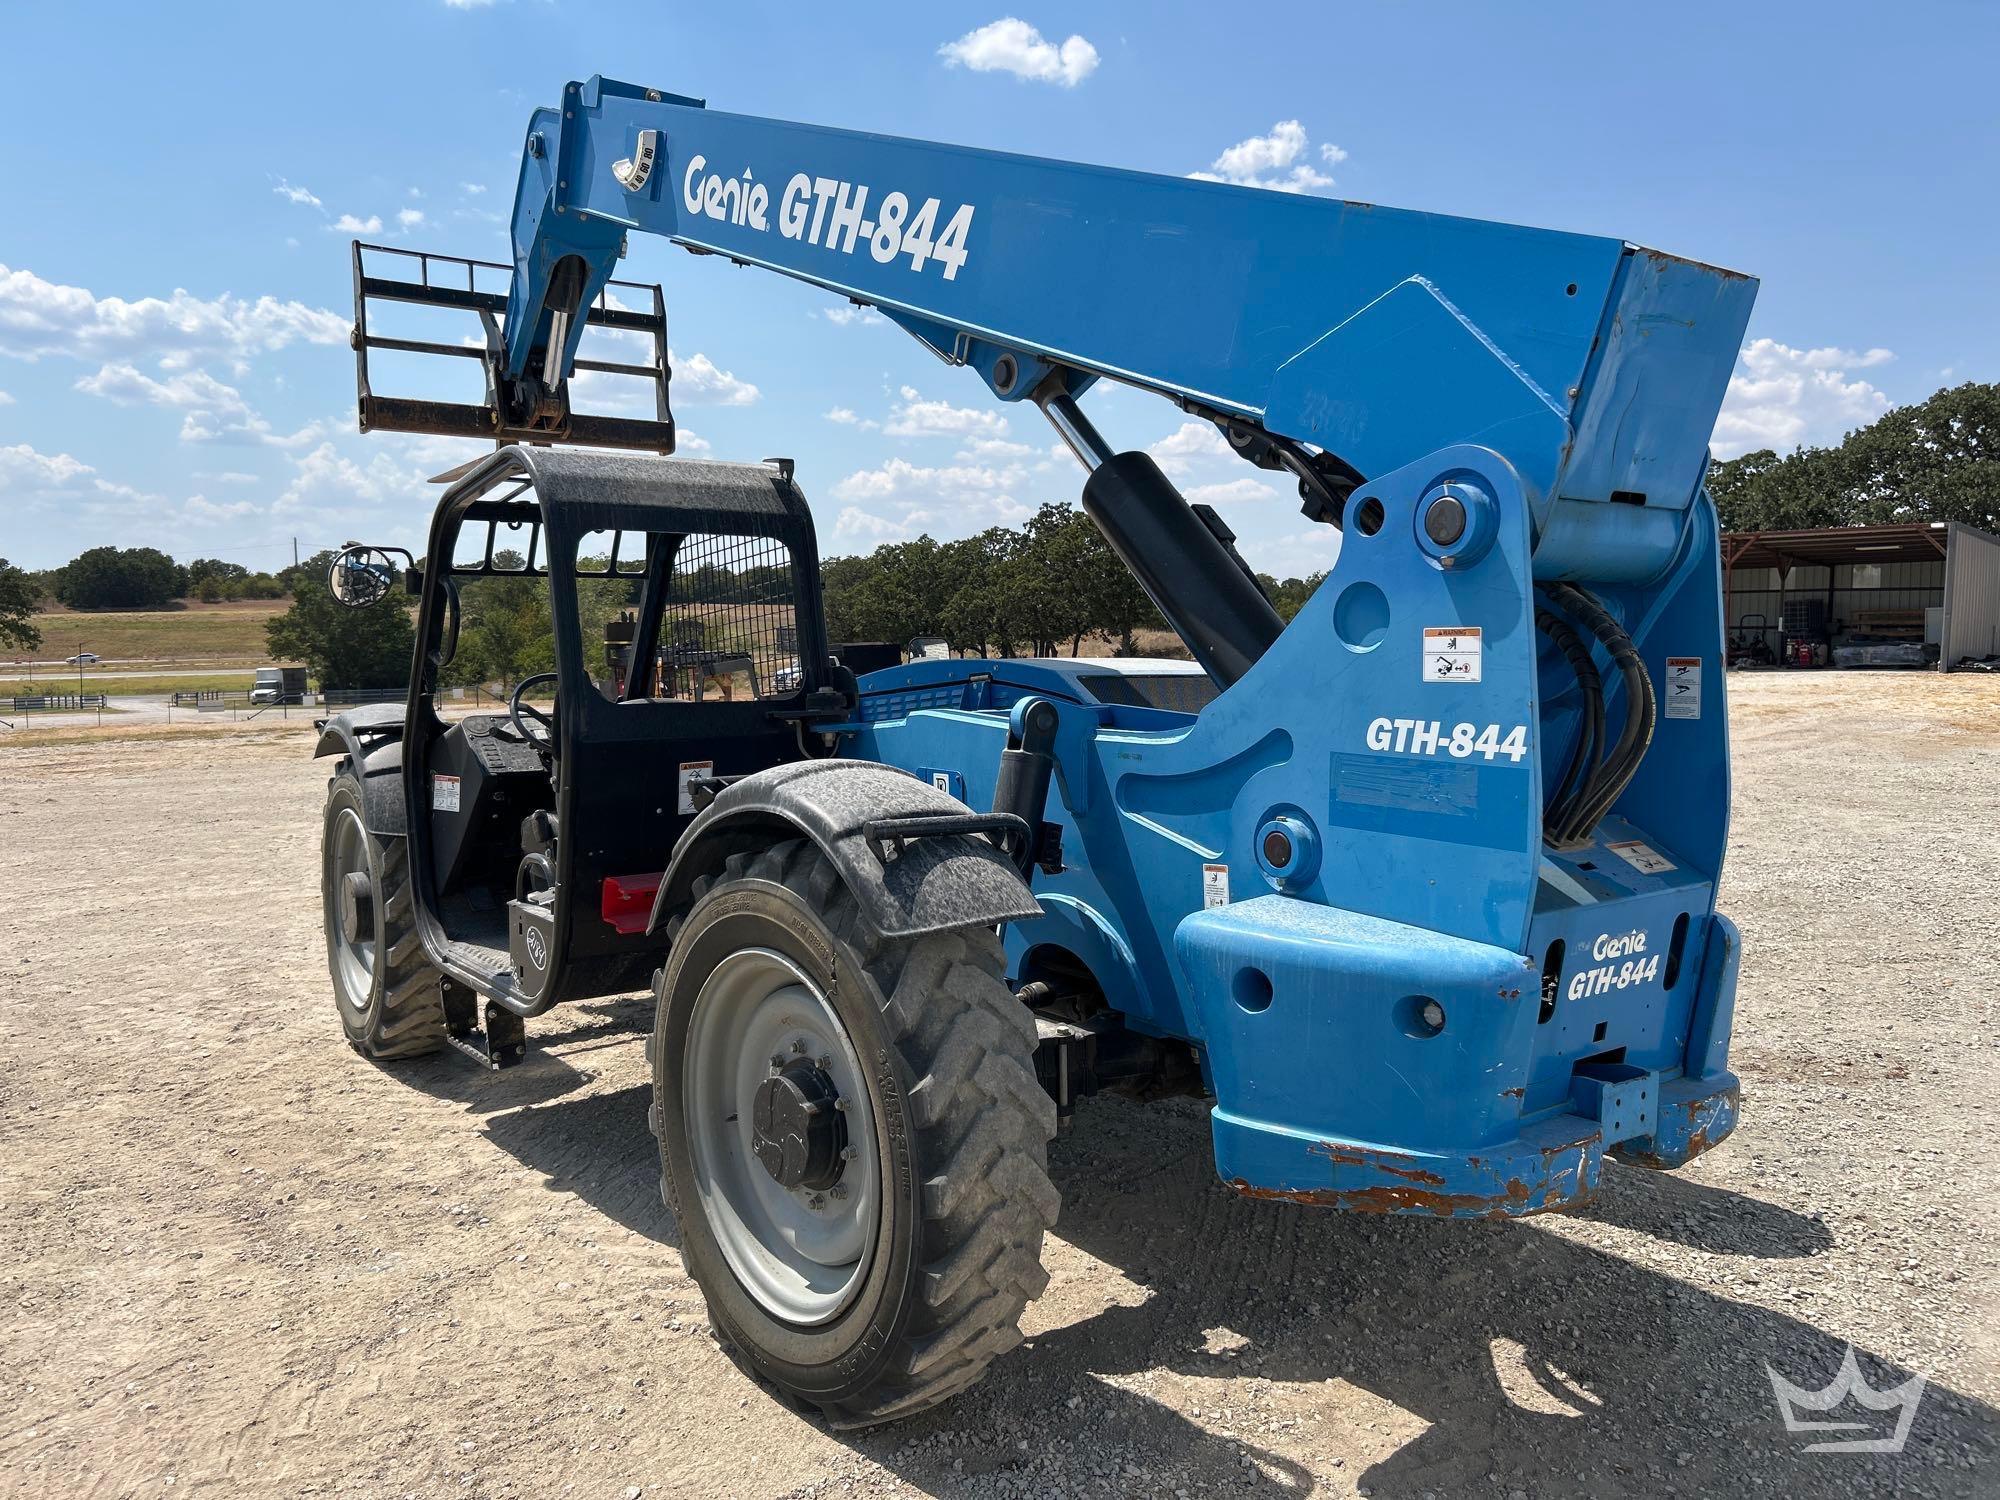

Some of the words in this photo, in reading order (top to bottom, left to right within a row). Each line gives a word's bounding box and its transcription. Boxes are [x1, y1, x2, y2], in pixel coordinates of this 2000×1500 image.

[640, 162, 650, 174] 60
[644, 147, 654, 160] 80
[635, 174, 645, 184] 40
[683, 154, 771, 232] Genie
[779, 173, 975, 281] GTH-844
[1366, 717, 1527, 762] GTH-844
[1593, 928, 1646, 962] Genie
[1568, 954, 1659, 1001] GTH-844
